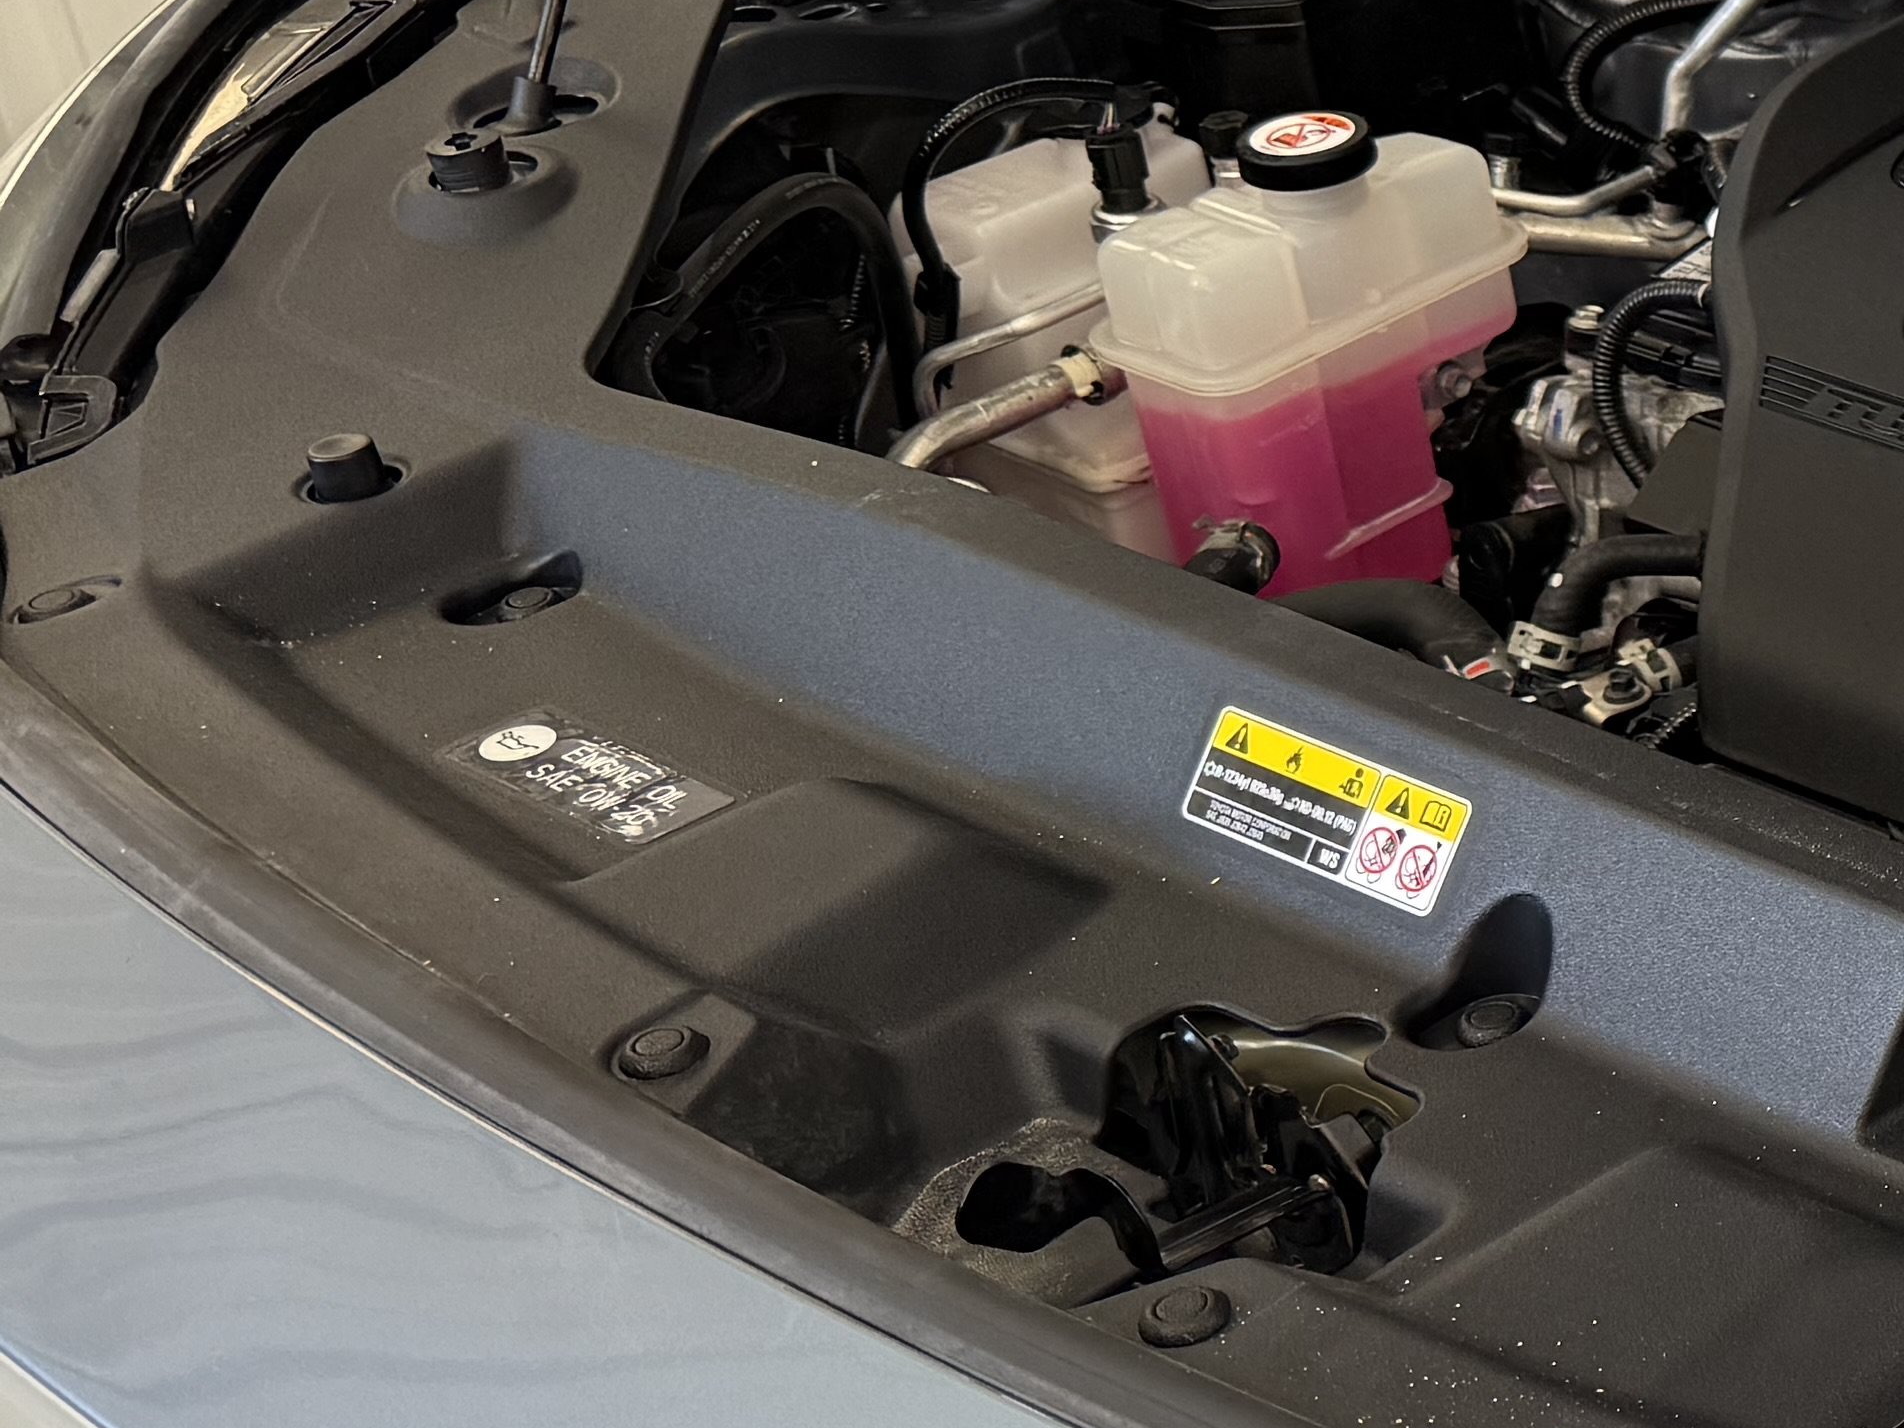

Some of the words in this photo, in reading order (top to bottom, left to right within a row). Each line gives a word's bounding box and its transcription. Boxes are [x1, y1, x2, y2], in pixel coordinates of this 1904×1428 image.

[526, 764, 584, 792] SAE
[561, 746, 652, 789] ENGINE
[646, 785, 688, 810] OIL
